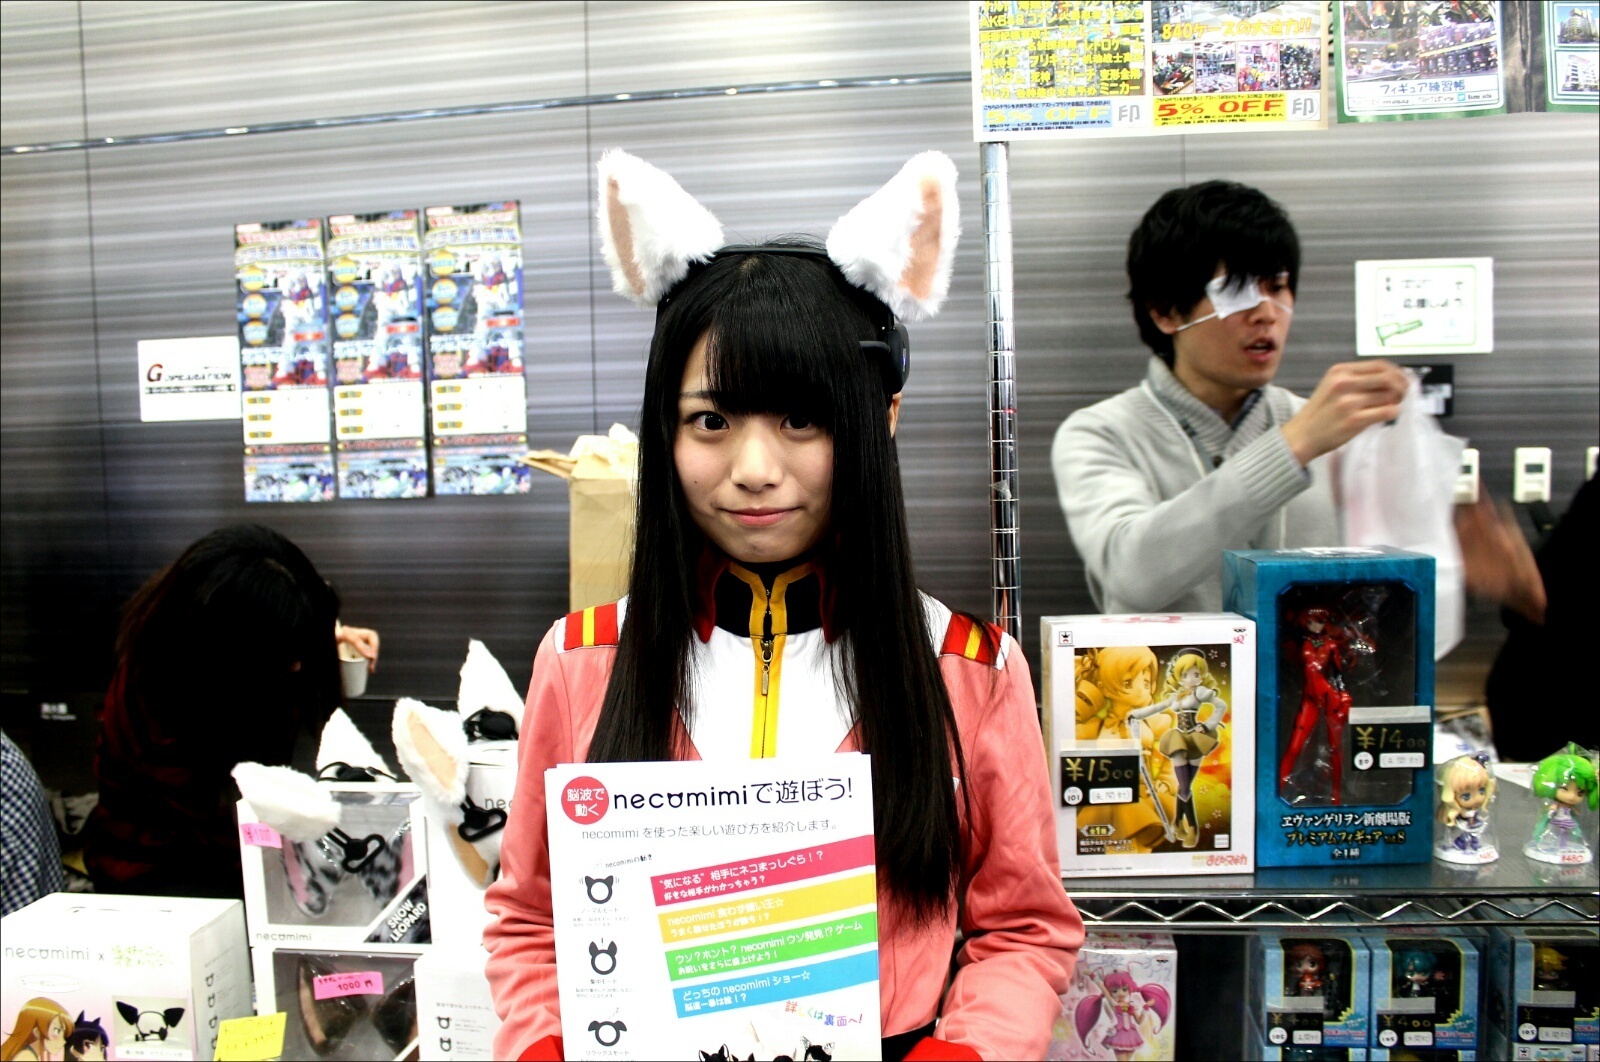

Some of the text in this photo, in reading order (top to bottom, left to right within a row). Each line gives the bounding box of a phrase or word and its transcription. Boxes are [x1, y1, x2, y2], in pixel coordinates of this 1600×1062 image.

[1083, 38, 1144, 51] レトロゲーム
[1030, 55, 1080, 67] プリキュア
[1099, 82, 1141, 95] ミニカー
[1380, 80, 1466, 94] フィギュア練習帳
[985, 105, 1111, 123] 5% OFF
[1118, 103, 1141, 122] 印
[1157, 99, 1284, 117] 5% OFF
[1292, 97, 1315, 116] 印
[1356, 726, 1426, 750] ¥1400
[1065, 758, 1134, 782] ¥1500
[567, 787, 605, 802] 脳波で
[575, 803, 599, 817] 動く
[1281, 812, 1412, 828] ヱヴァンゲリヲン新劇場版
[582, 819, 837, 840] necomimi を使った楽しい遊び方を紹介します。
[1287, 831, 1382, 846] プレミアムフィギュア
[664, 875, 765, 901] 好きな相手がわかっちゃう？
[387, 899, 414, 929] SNOW
[389, 902, 427, 942] LEOPARD
[667, 912, 715, 927] necomimi
[256, 933, 312, 941] necomimi
[741, 938, 785, 954] necomimi
[836, 920, 863, 936] ゲーム
[5, 947, 90, 961] necomimi
[683, 985, 721, 1001] どっちの
[723, 977, 770, 996] necomimi
